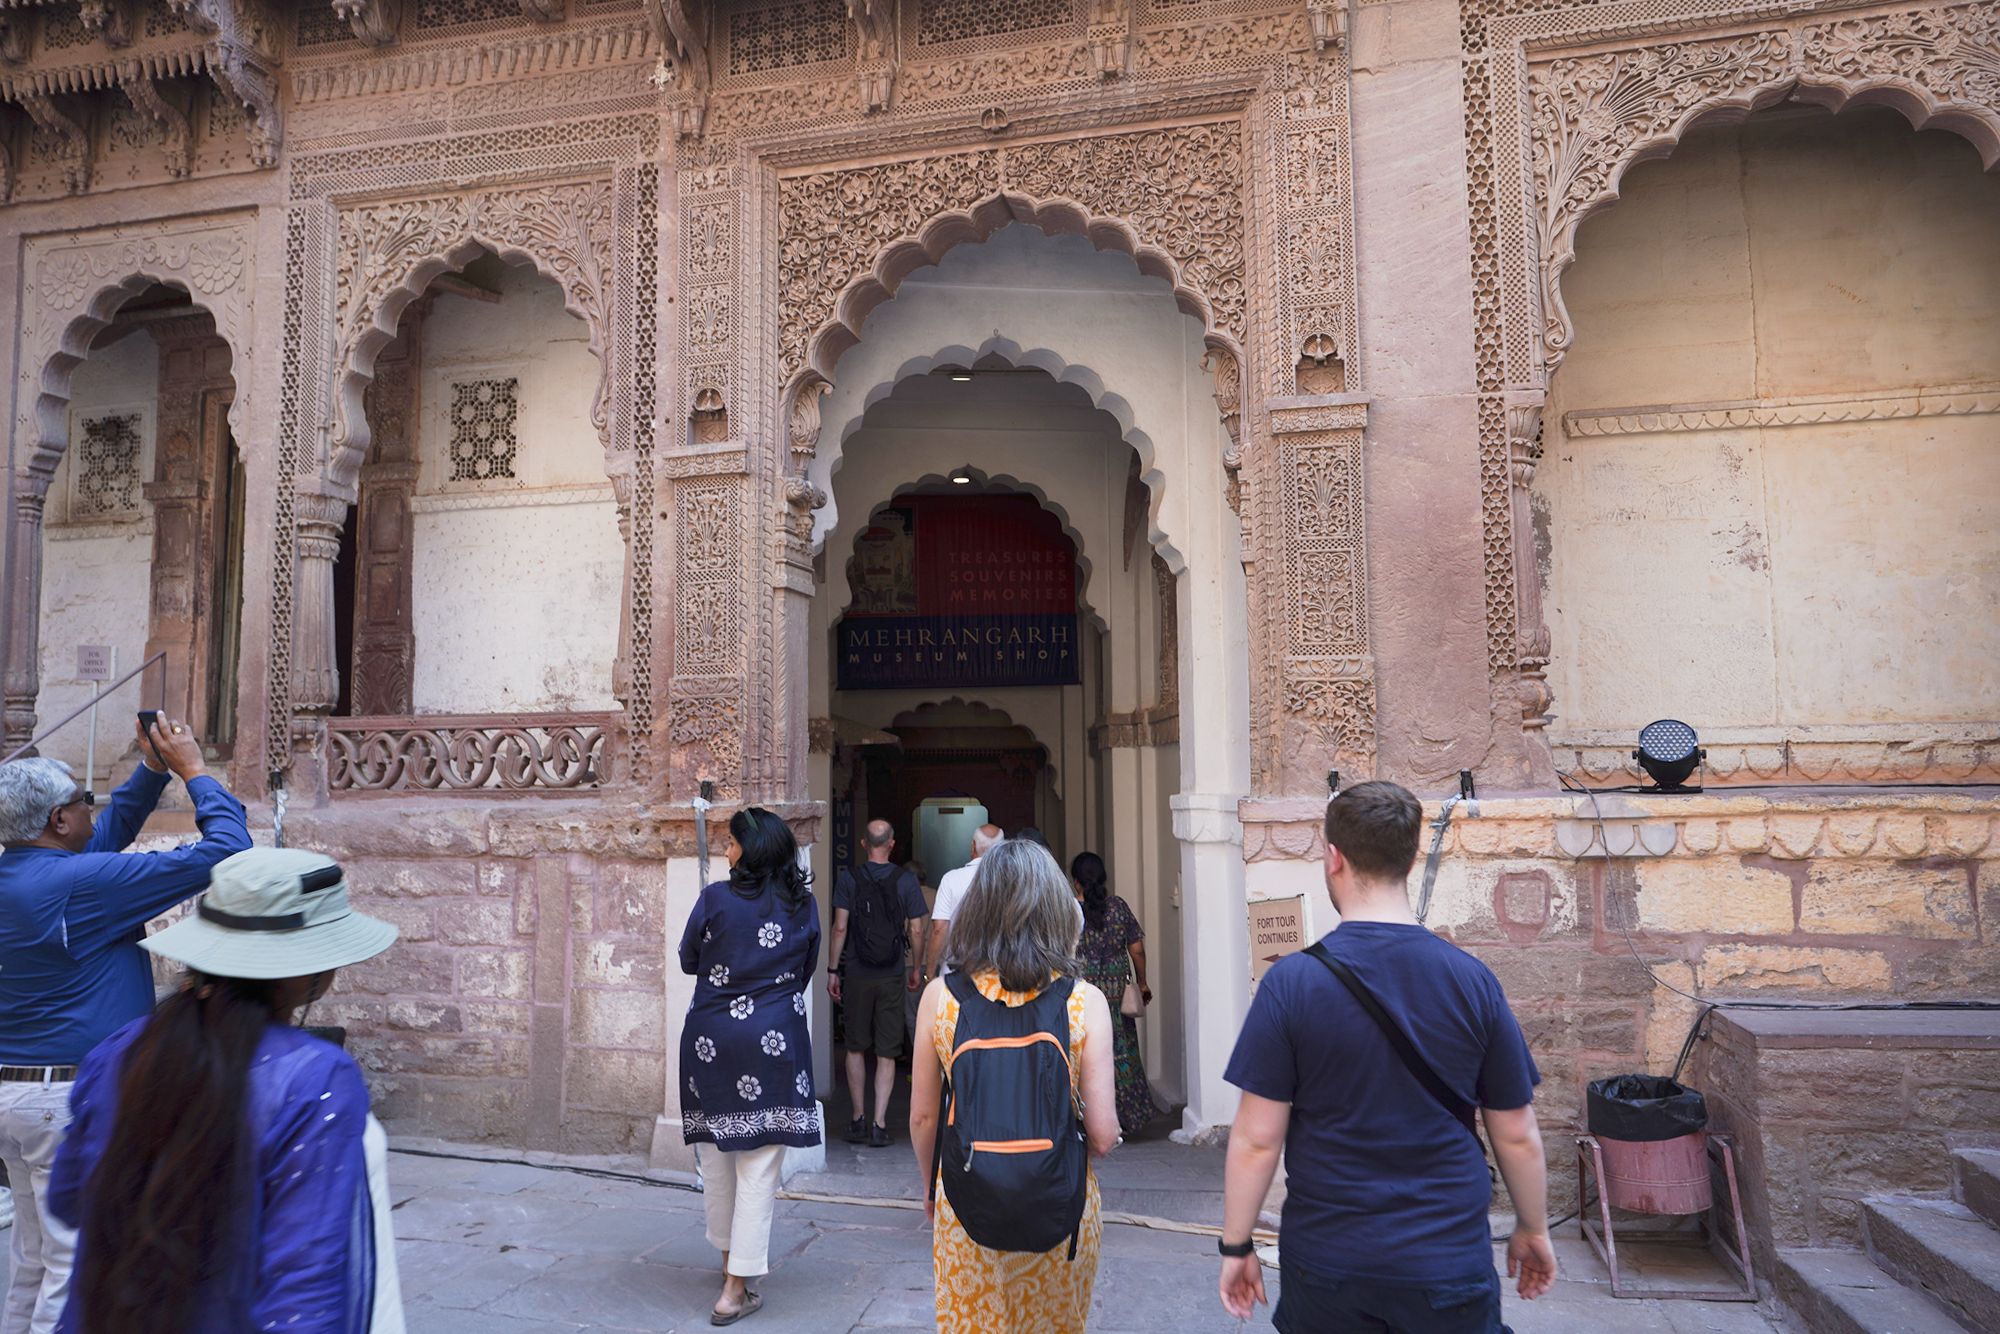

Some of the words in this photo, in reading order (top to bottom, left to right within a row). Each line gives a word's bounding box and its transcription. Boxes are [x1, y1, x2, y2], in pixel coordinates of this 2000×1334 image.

[948, 550, 1067, 564] TREASURES
[949, 568, 1067, 582] SOUVENIRS
[949, 587, 1067, 601] MEMORIES
[848, 626, 1069, 648] MEHRANGARH
[848, 651, 968, 664] MUSEUM
[995, 649, 1068, 662] SHOP
[1256, 917, 1274, 929] FORT
[1274, 915, 1296, 928] TOUR
[1257, 931, 1298, 944] CONTINUES
